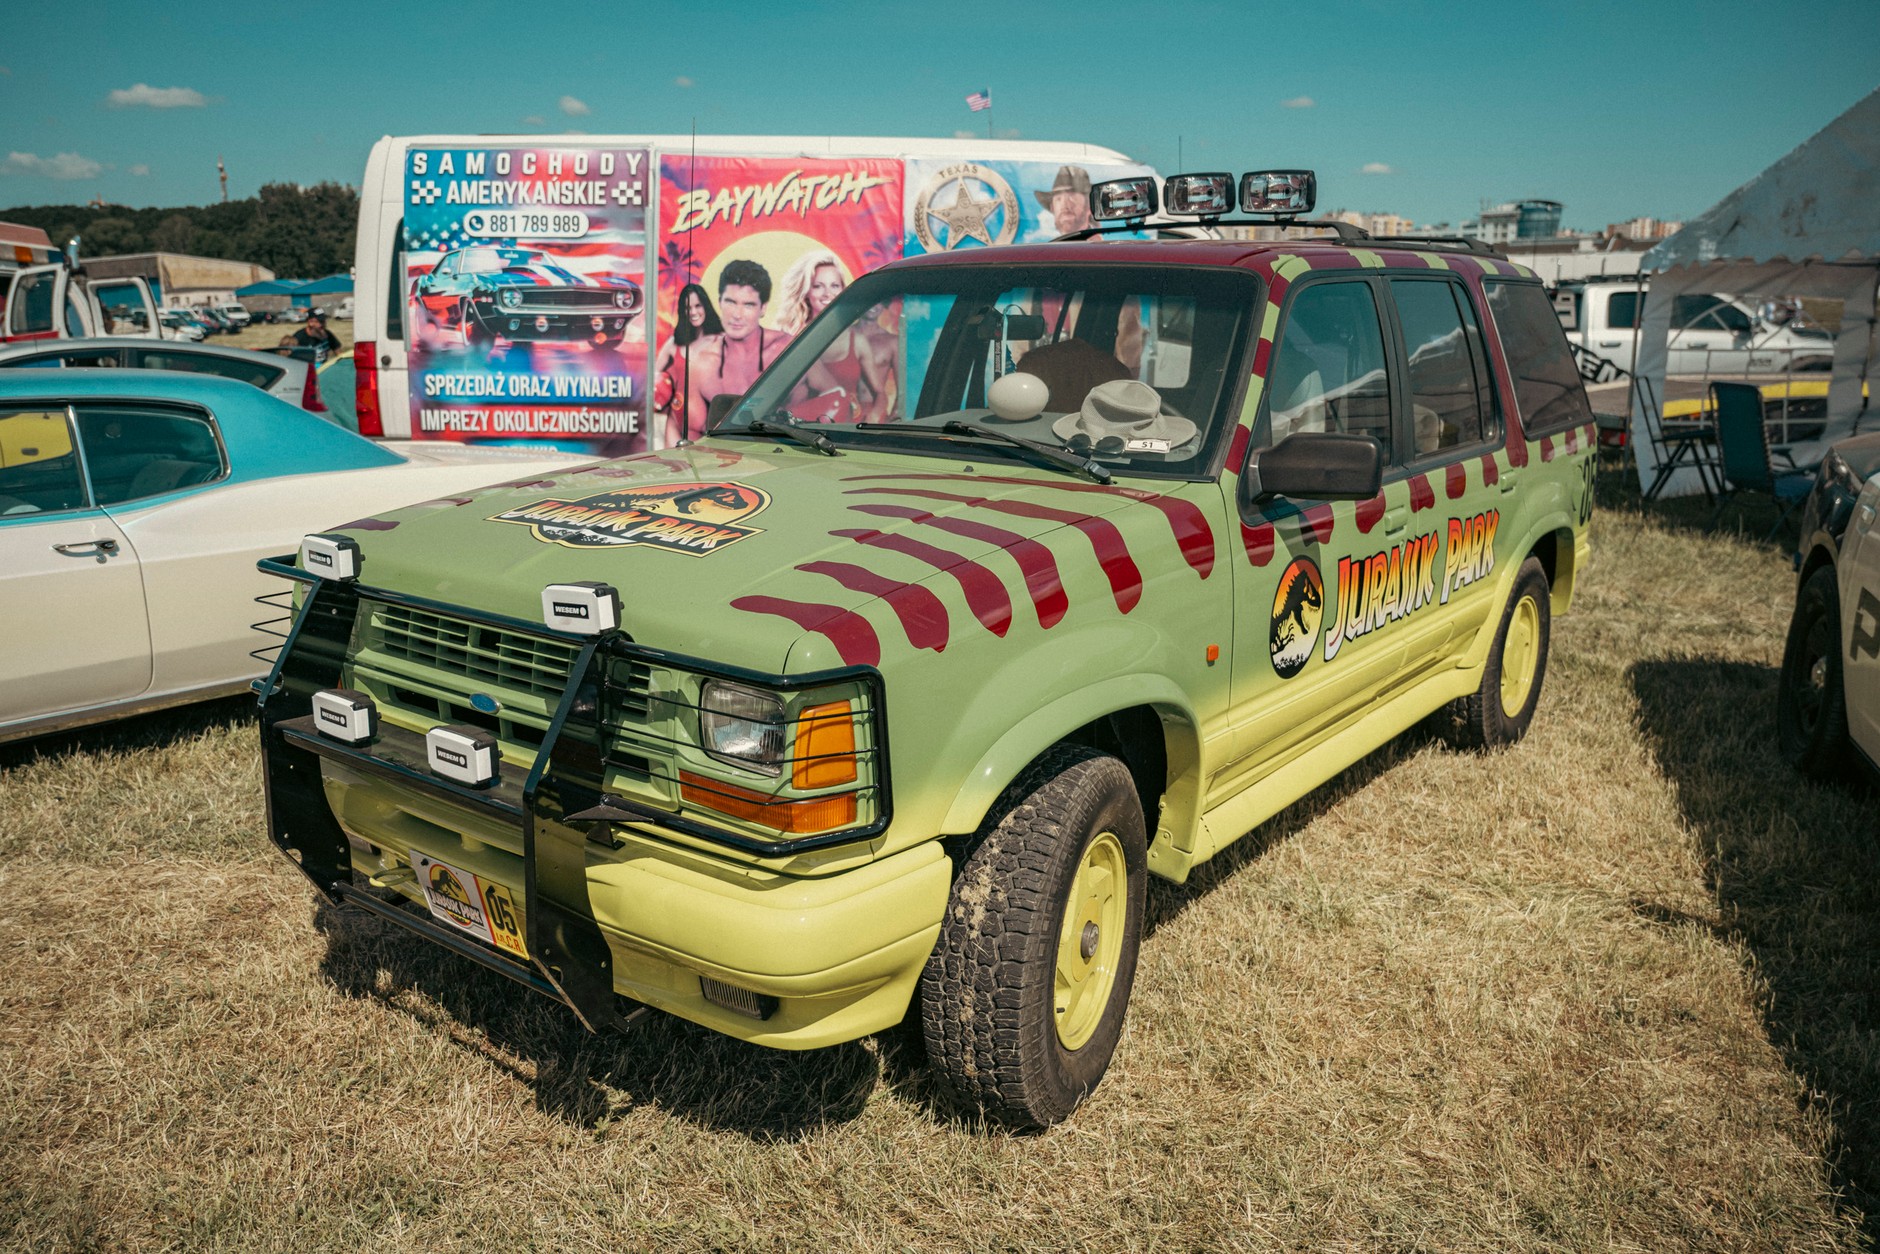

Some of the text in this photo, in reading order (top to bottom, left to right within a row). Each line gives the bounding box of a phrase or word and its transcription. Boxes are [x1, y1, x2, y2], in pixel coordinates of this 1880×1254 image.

[413, 152, 643, 175] SAMOCHODY
[938, 164, 978, 178] TEXAS
[446, 177, 607, 205] AMERYKAŃSKIE
[670, 169, 895, 234] BAYWATCH
[490, 215, 581, 233] 881 789 989
[425, 371, 632, 397] SPRZEDAŻ ORAZ WYNAJEM
[420, 407, 639, 433] IMPREZY OKOLICZNOŚCIOWE
[500, 501, 743, 549] JURASSIC PARK
[1324, 508, 1500, 661] JURASSIC PARK
[555, 605, 579, 614] WESEM
[321, 710, 340, 722] WESEM
[437, 750, 459, 763] WESEM
[486, 888, 518, 936] 05
